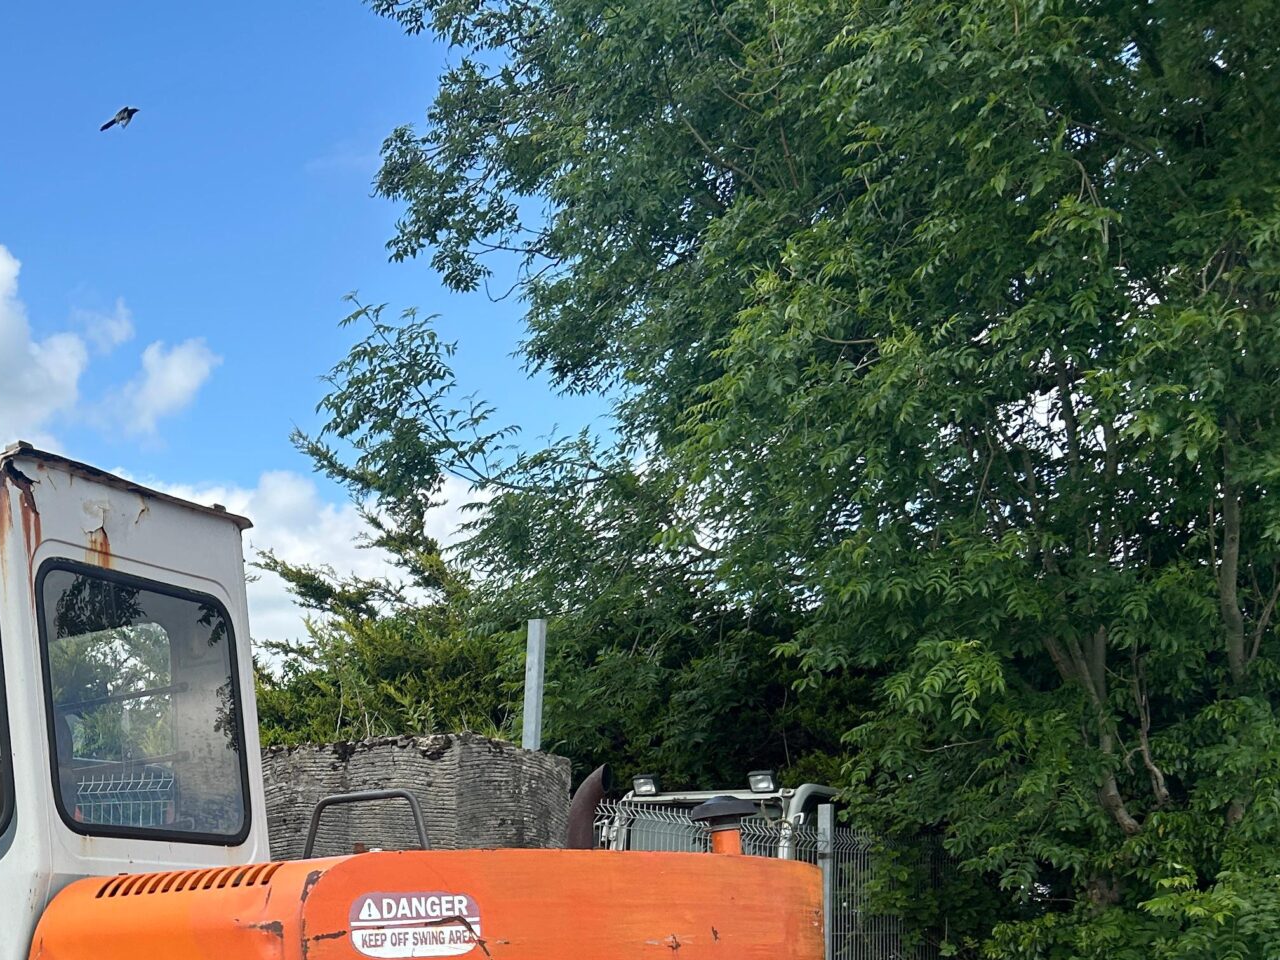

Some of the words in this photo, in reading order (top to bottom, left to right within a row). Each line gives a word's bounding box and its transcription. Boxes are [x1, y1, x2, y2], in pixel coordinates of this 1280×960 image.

[382, 895, 468, 919] DANGER
[361, 932, 387, 949] KEEP
[390, 931, 409, 947] OFF
[412, 930, 446, 946] SWING
[448, 929, 475, 944] AREA
